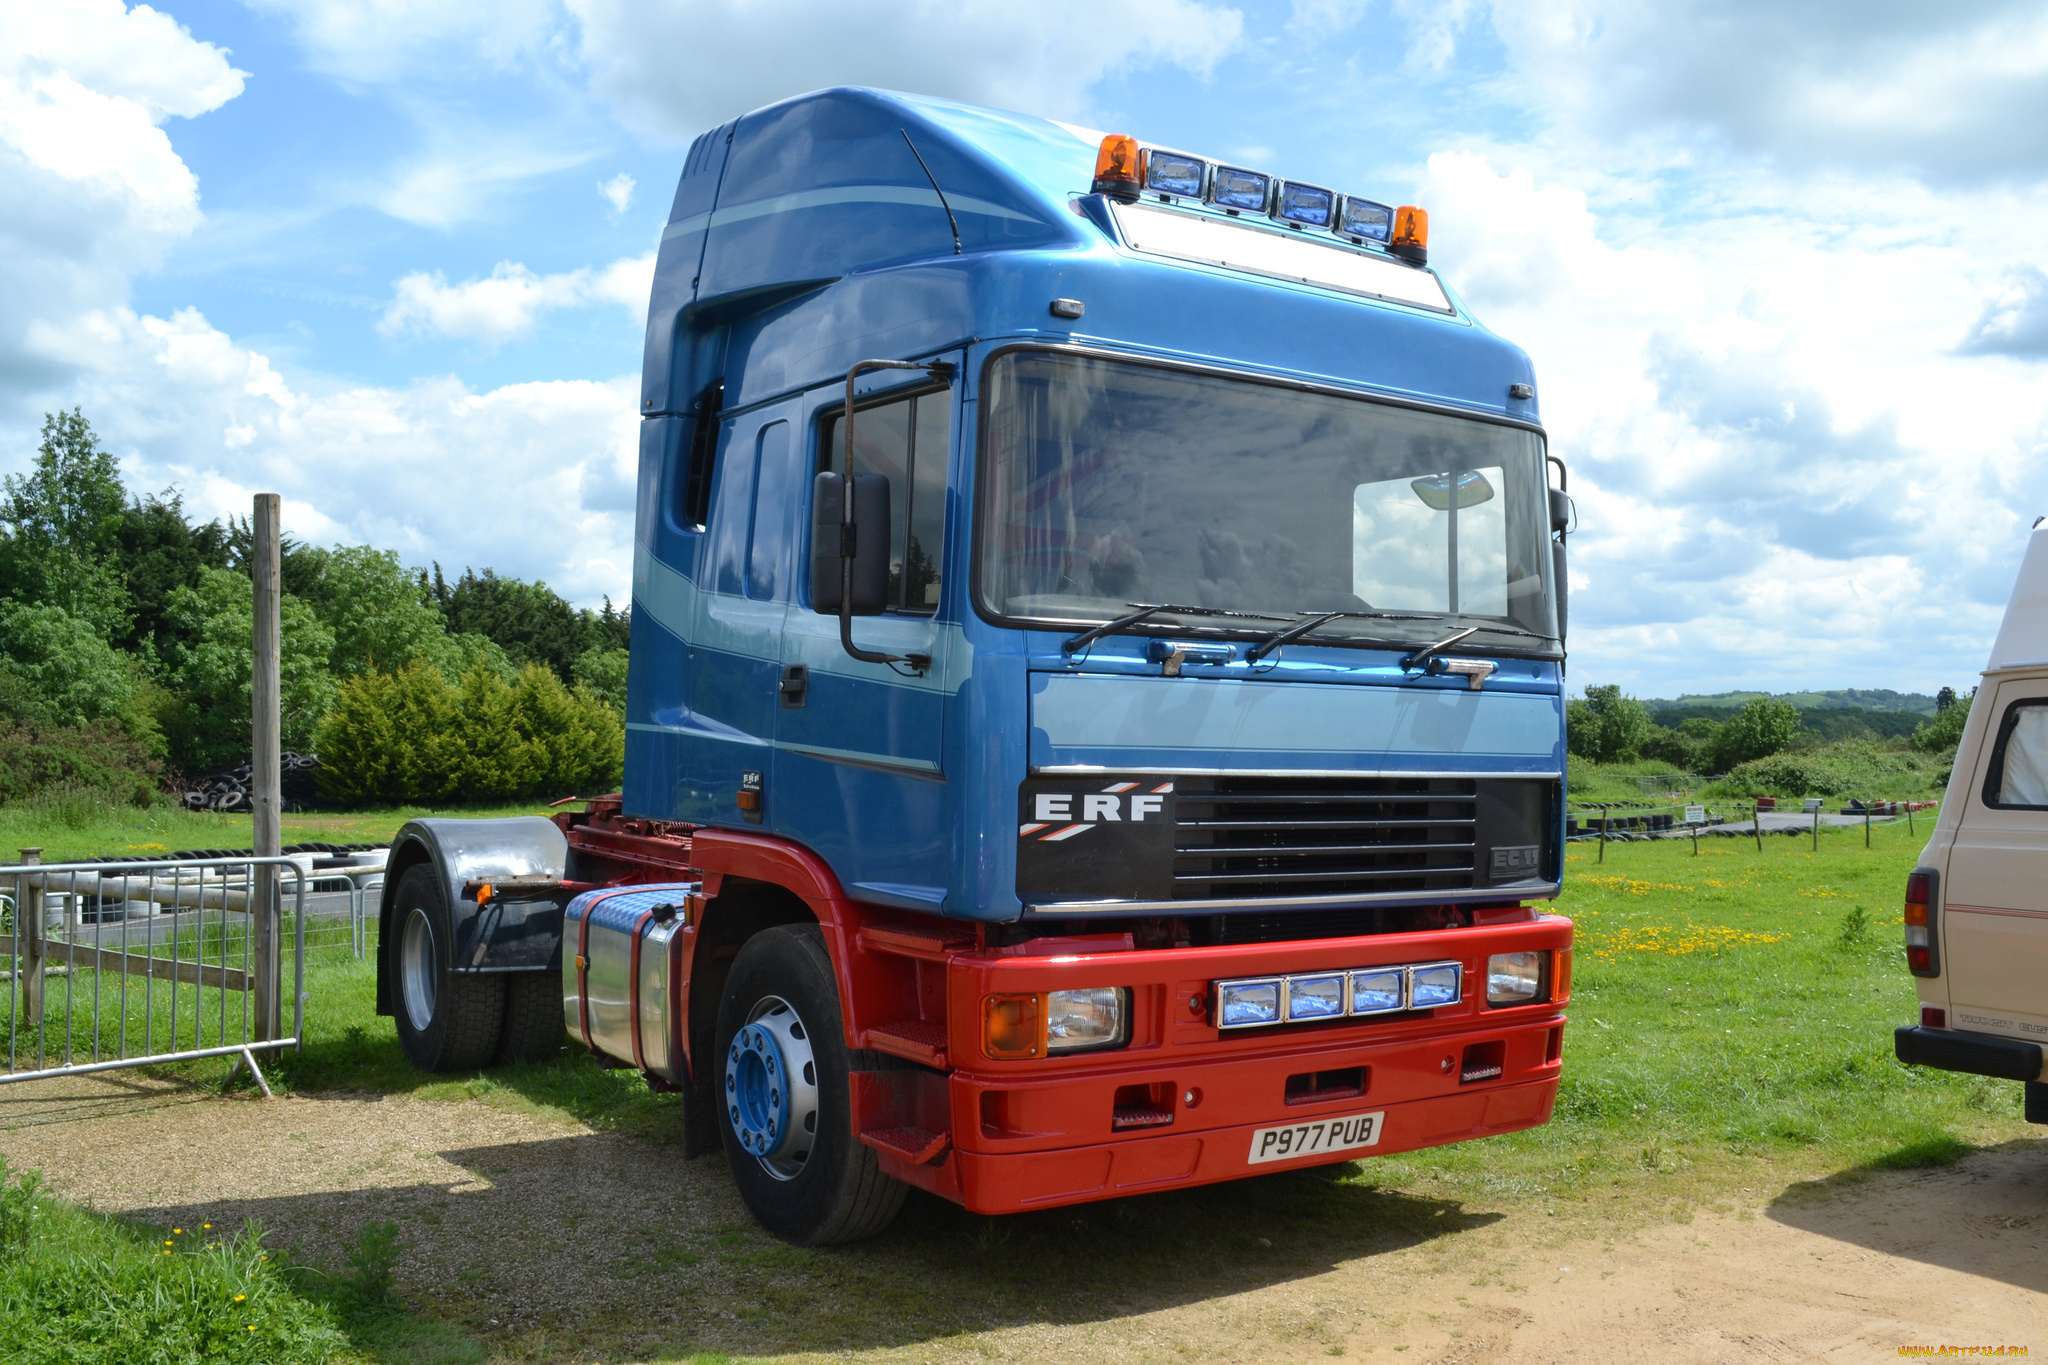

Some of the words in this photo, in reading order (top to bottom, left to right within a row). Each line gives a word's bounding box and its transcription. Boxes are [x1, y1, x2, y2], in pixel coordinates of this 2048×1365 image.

[743, 774, 760, 783] ERF
[1035, 793, 1164, 822] ERF
[1493, 850, 1520, 867] EC
[1959, 1013, 2013, 1029] TRANSIT
[2019, 1022, 2048, 1034] CUS
[1260, 1124, 1326, 1157] P977
[1327, 1117, 1374, 1147] PUB
